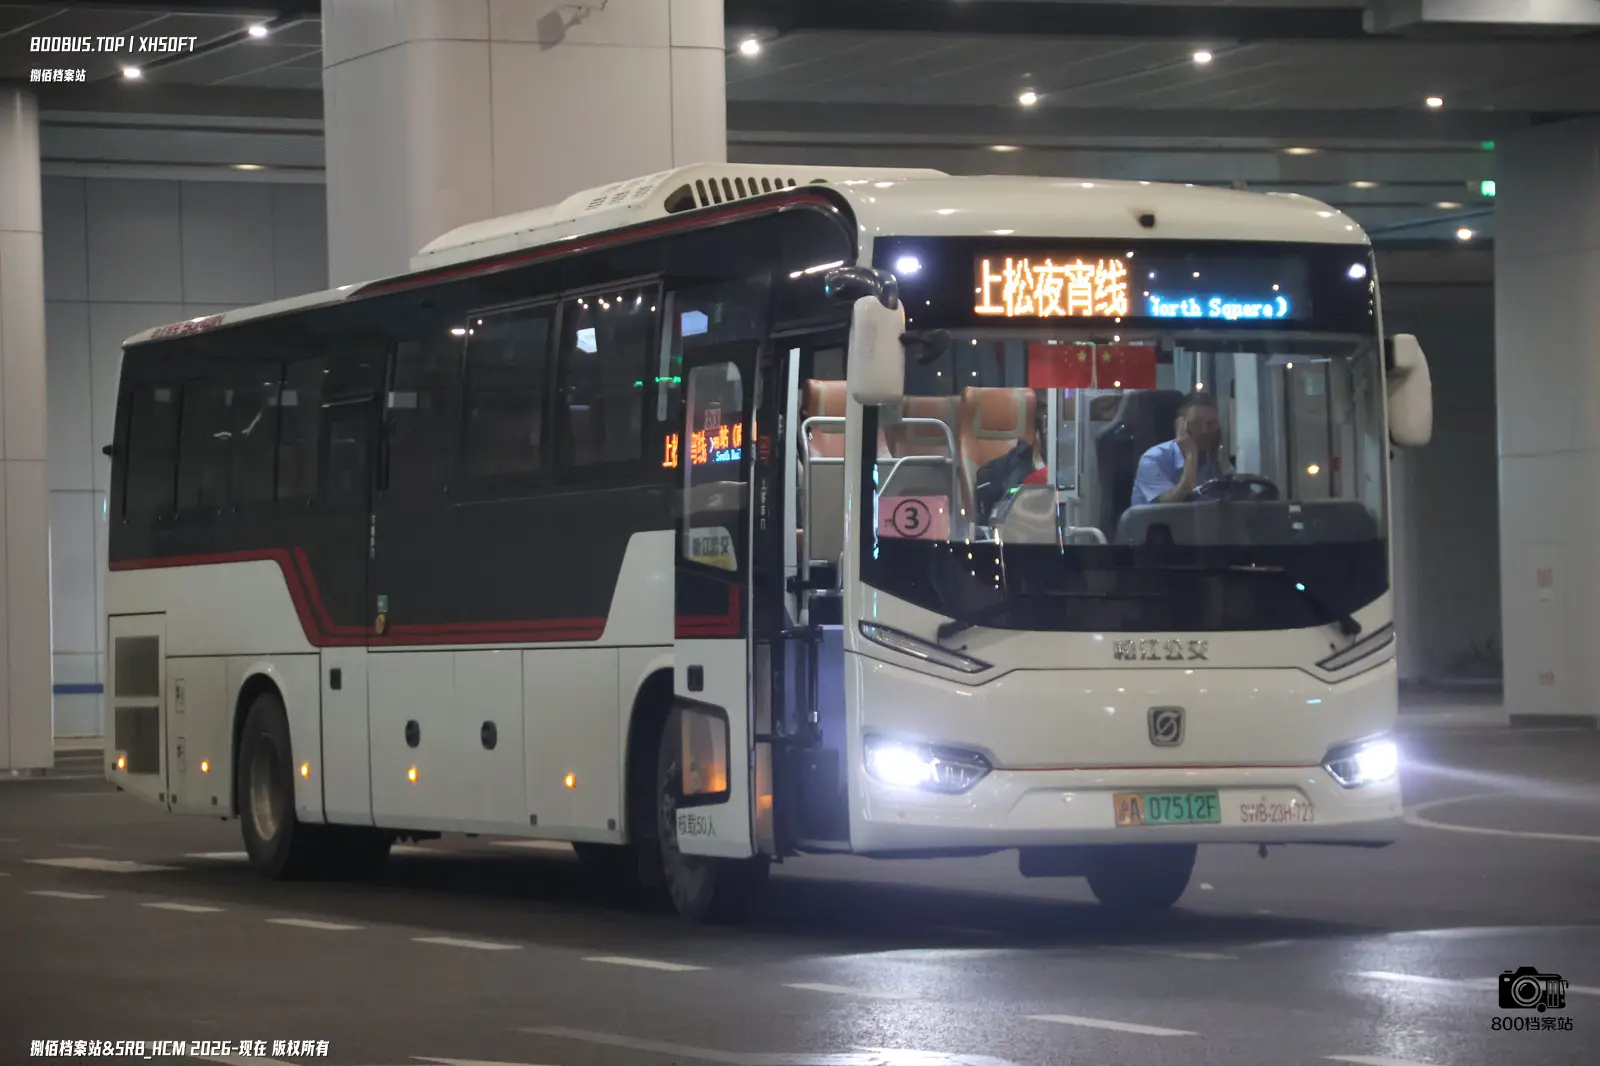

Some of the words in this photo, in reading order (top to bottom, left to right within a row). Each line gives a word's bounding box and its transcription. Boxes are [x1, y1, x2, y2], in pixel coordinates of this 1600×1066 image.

[973, 257, 1129, 317] 上松夜宵线
[678, 813, 717, 837] 核载50人
